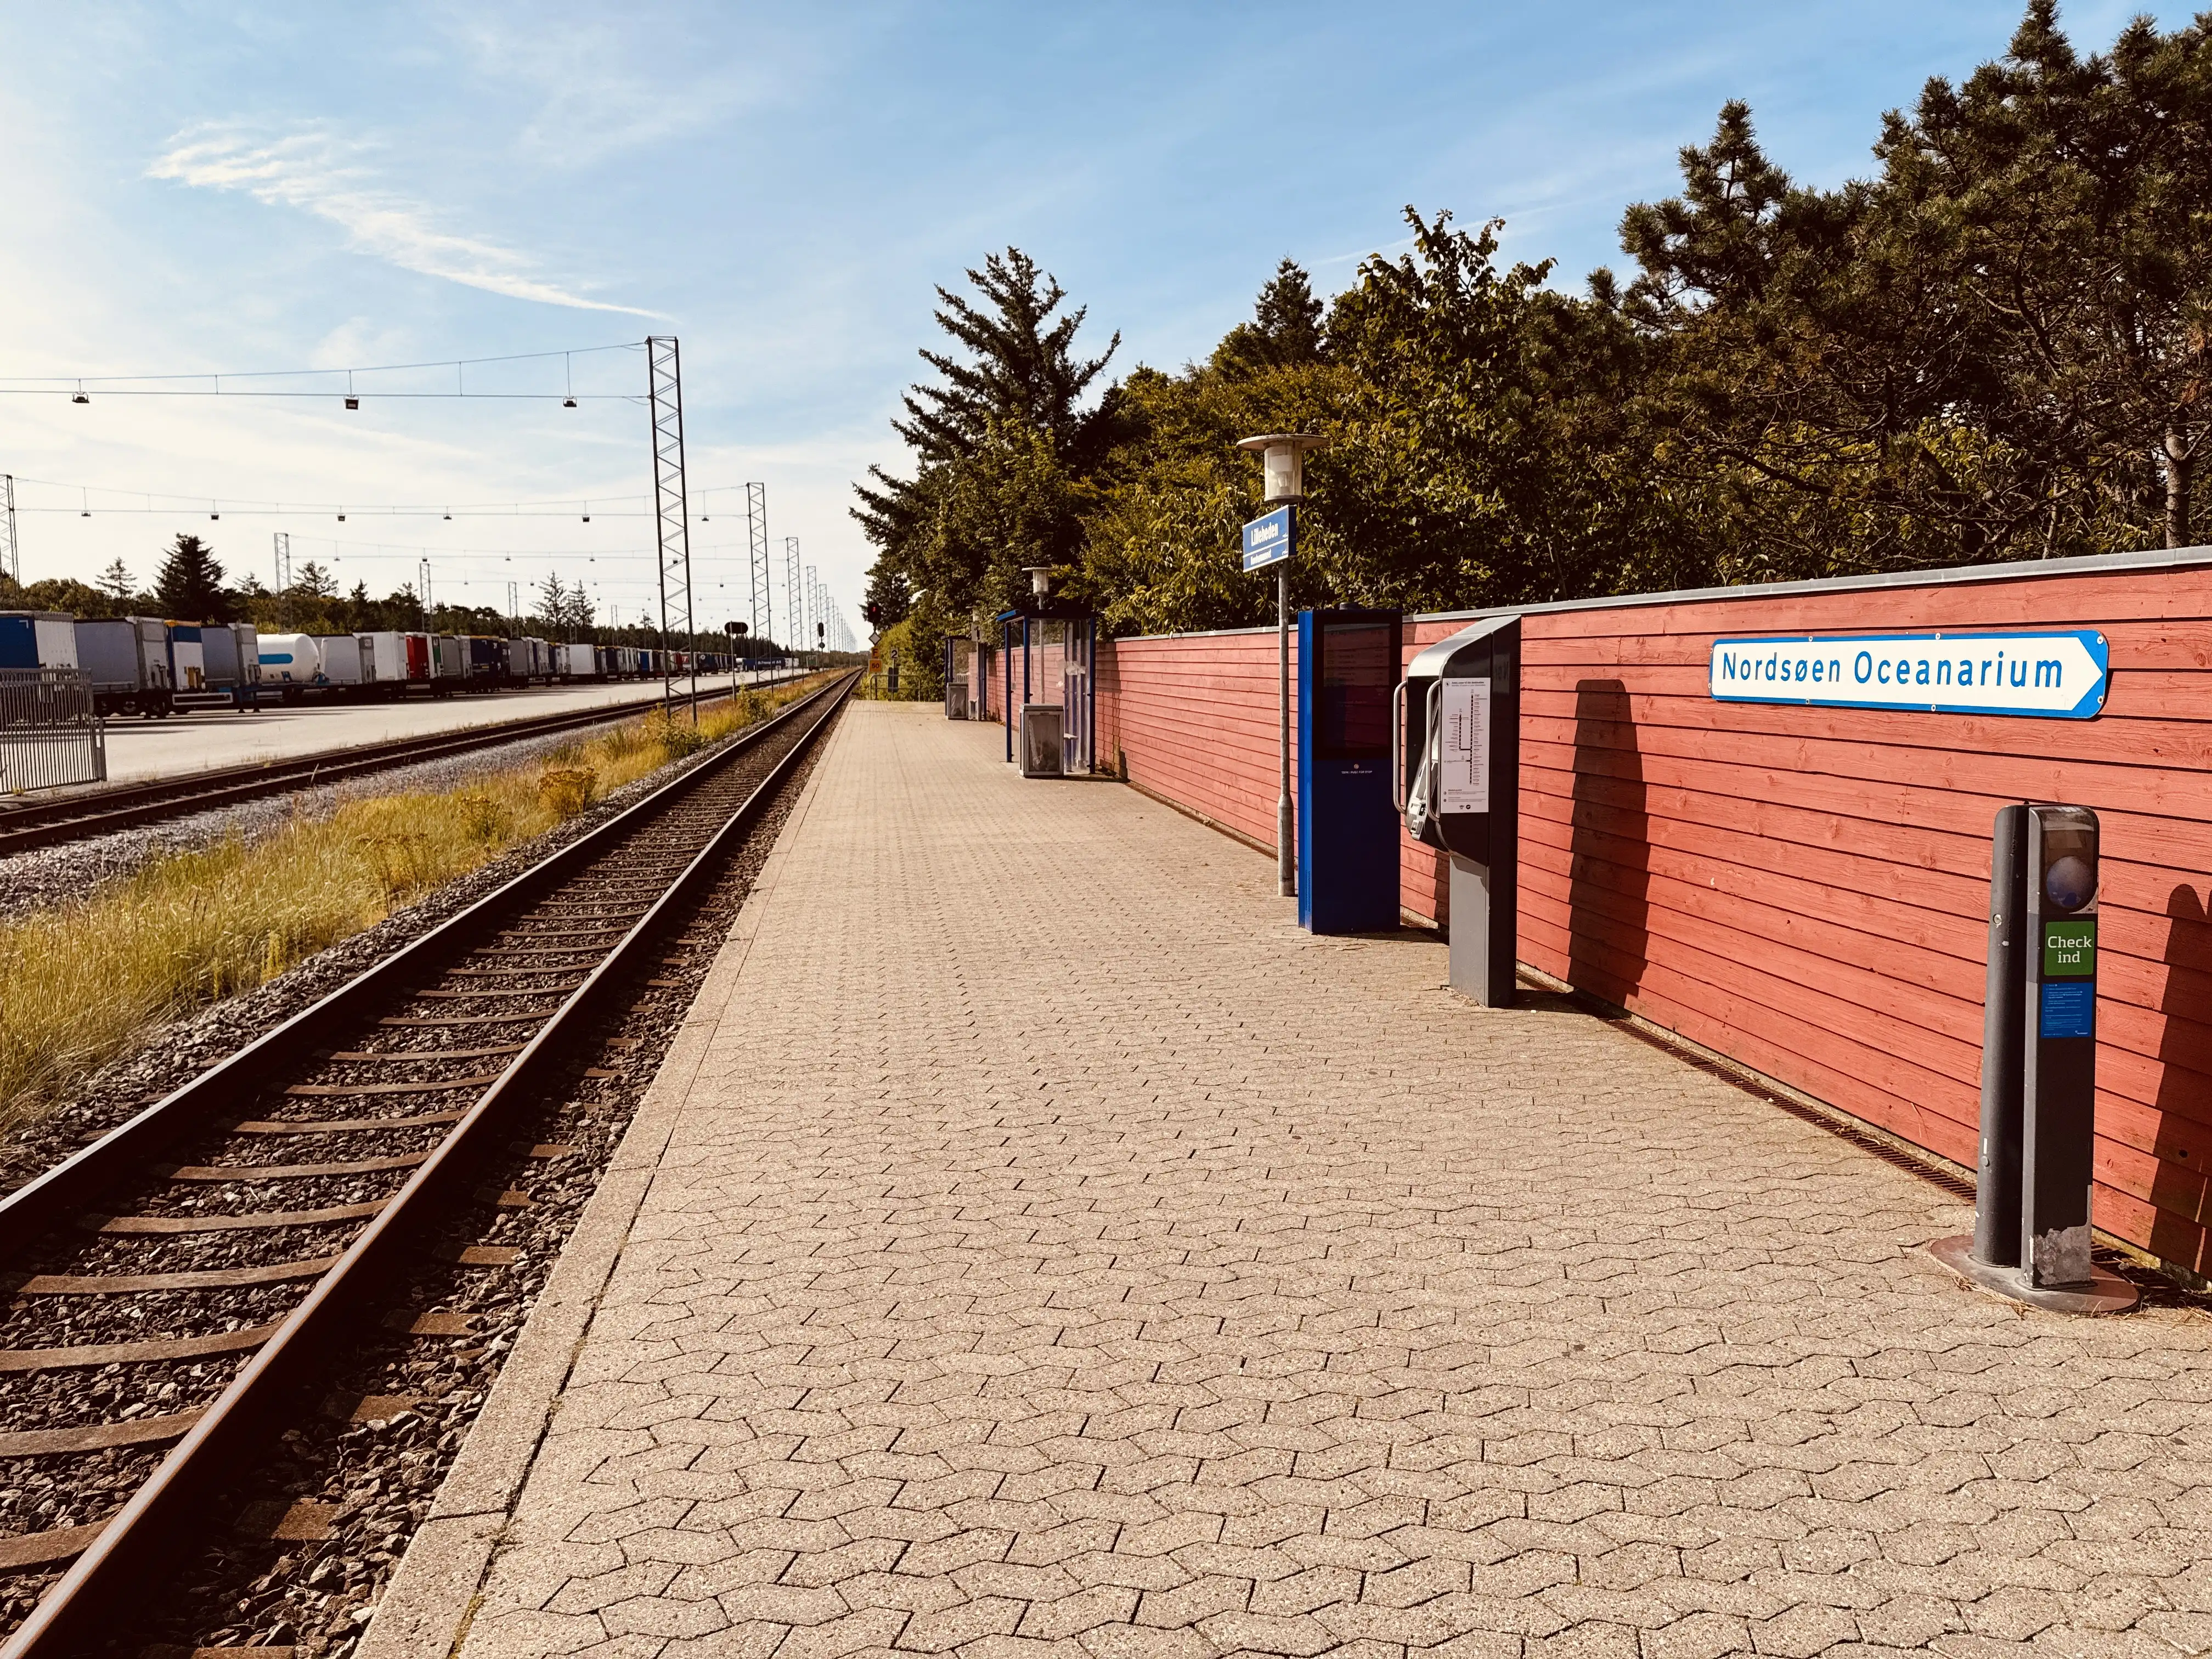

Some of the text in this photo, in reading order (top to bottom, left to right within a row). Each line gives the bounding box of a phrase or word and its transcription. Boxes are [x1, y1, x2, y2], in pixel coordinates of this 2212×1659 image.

[1251, 522, 1278, 546] Lilleheden
[873, 648, 878, 656] F
[891, 650, 898, 658] 2
[1723, 651, 2062, 688] Nordsøen Oceanarium
[2047, 935, 2092, 949] Check
[2057, 950, 2081, 963] ind
